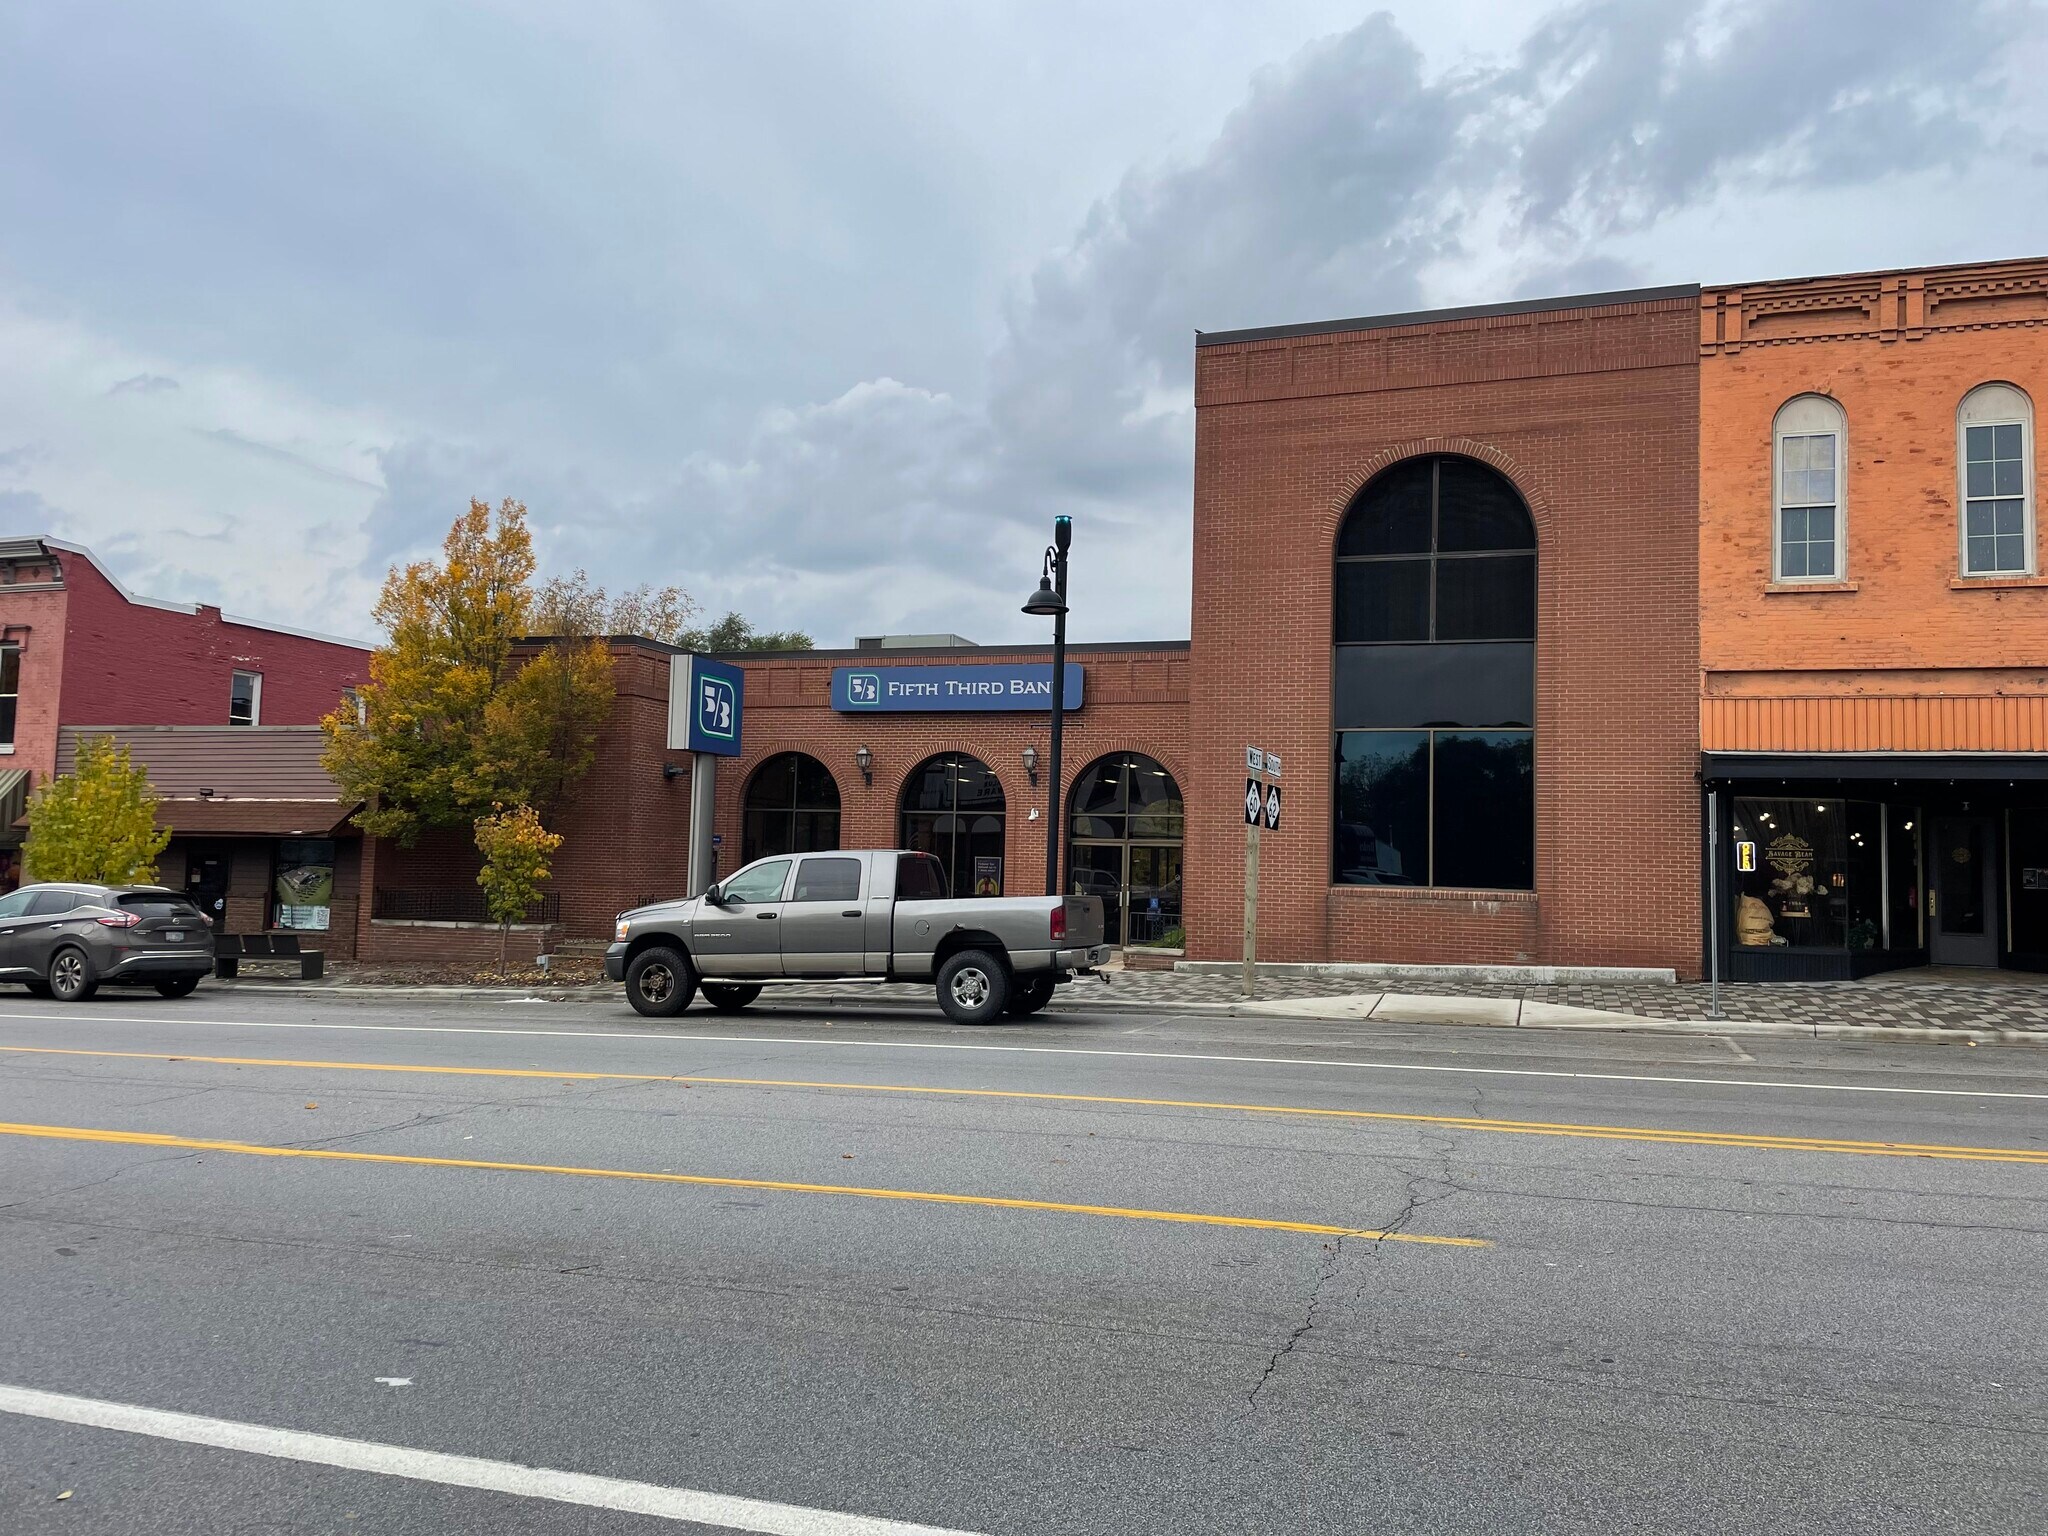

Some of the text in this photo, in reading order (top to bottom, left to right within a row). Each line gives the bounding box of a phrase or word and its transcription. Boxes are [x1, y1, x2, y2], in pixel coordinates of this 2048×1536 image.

[888, 681, 939, 696] FIFTH
[945, 680, 1004, 696] THIRD
[1010, 680, 1064, 695] BAN
[1249, 750, 1261, 767] WEST
[1250, 797, 1258, 813] 60
[1269, 803, 1277, 819] 62
[1742, 843, 1750, 870] OPEN
